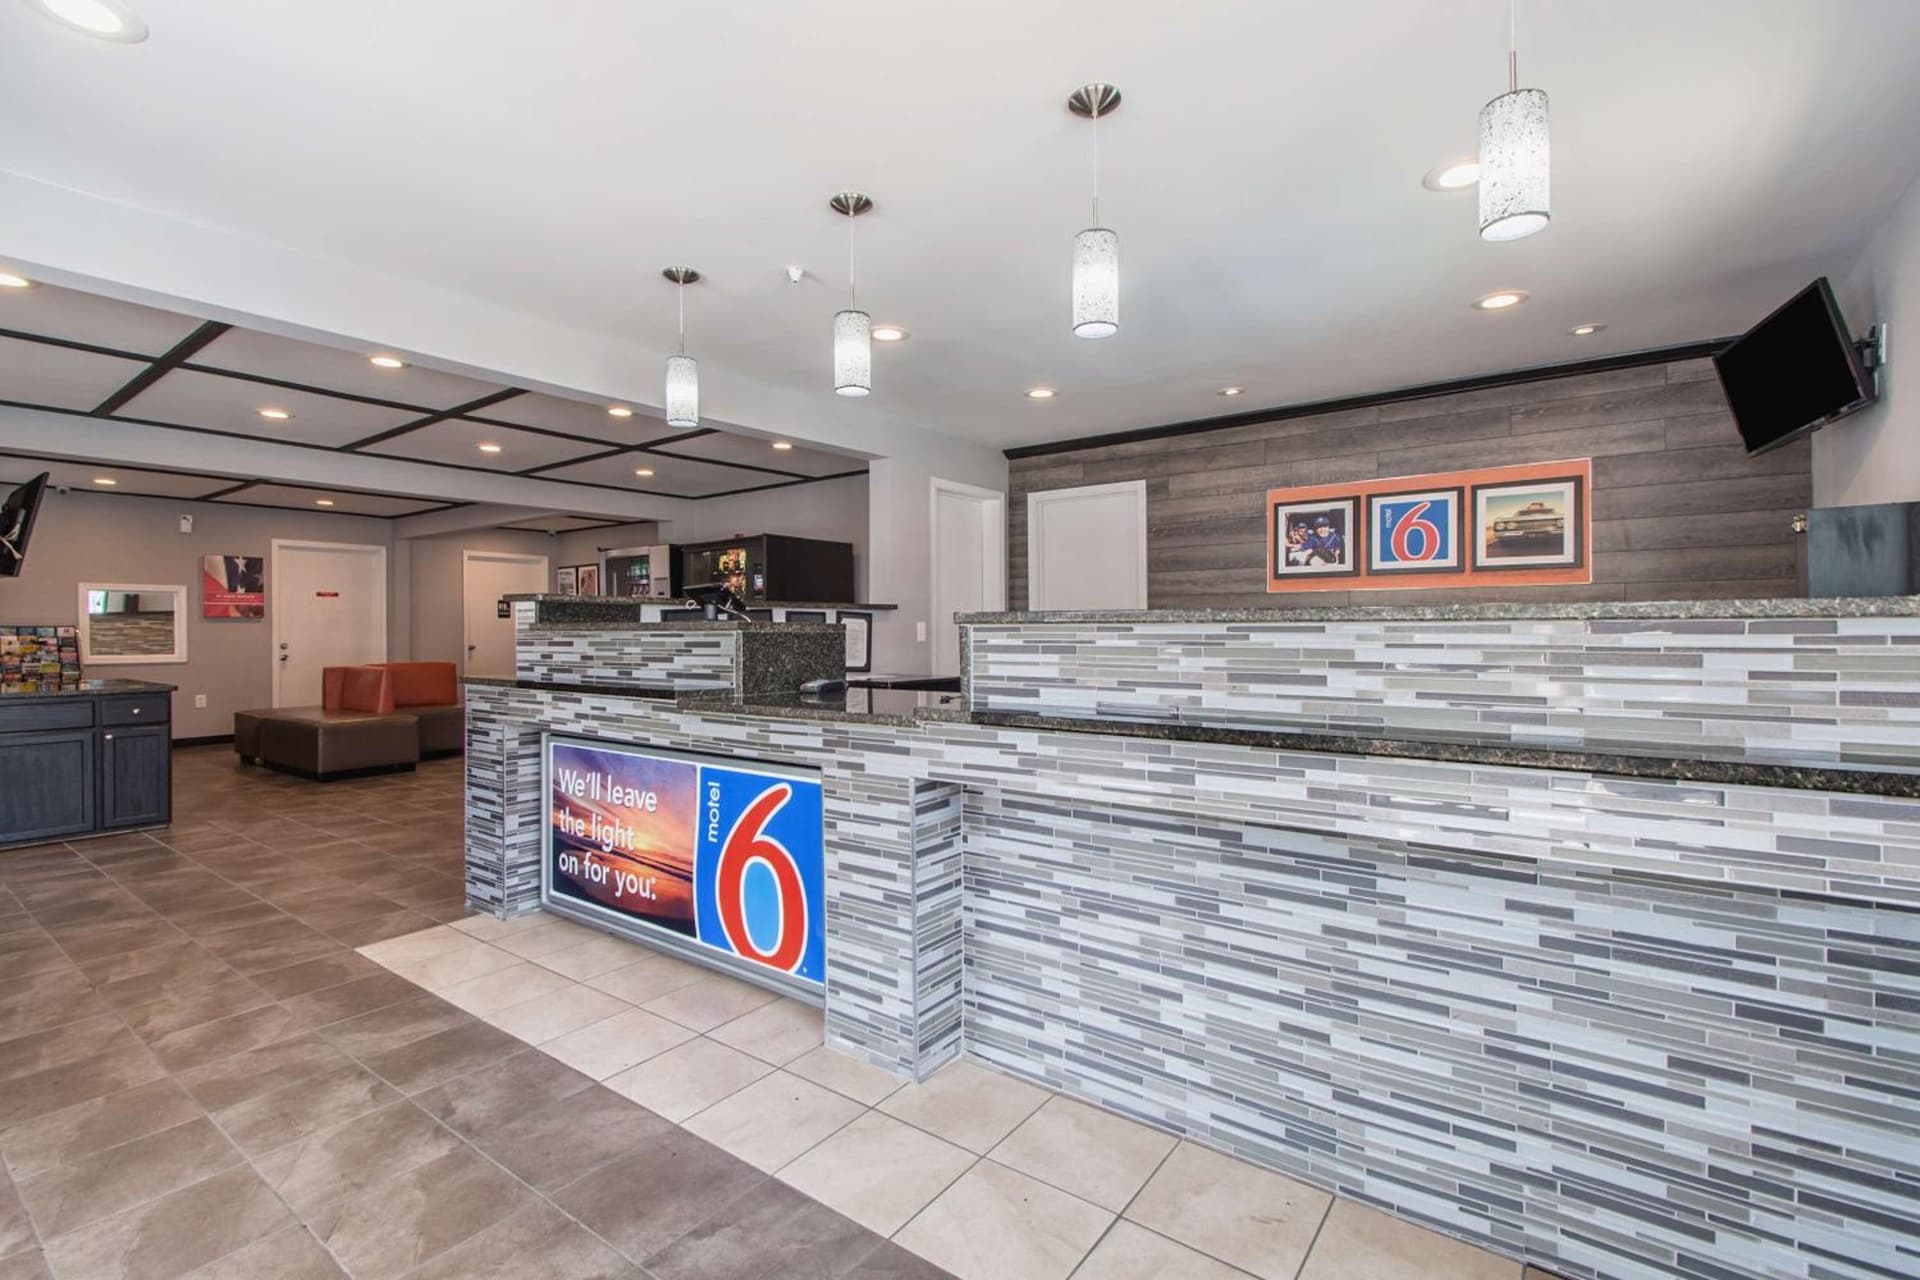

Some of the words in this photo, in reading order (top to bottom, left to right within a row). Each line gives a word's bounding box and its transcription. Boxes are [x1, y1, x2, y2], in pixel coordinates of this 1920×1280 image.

[1390, 501, 1440, 562] 6
[558, 767, 601, 801] We'll
[607, 774, 657, 812] leave
[559, 806, 585, 837] the
[592, 813, 635, 852] light
[559, 853, 578, 875] on
[583, 852, 610, 885] for
[707, 781, 720, 843] motel
[715, 782, 808, 975] 6
